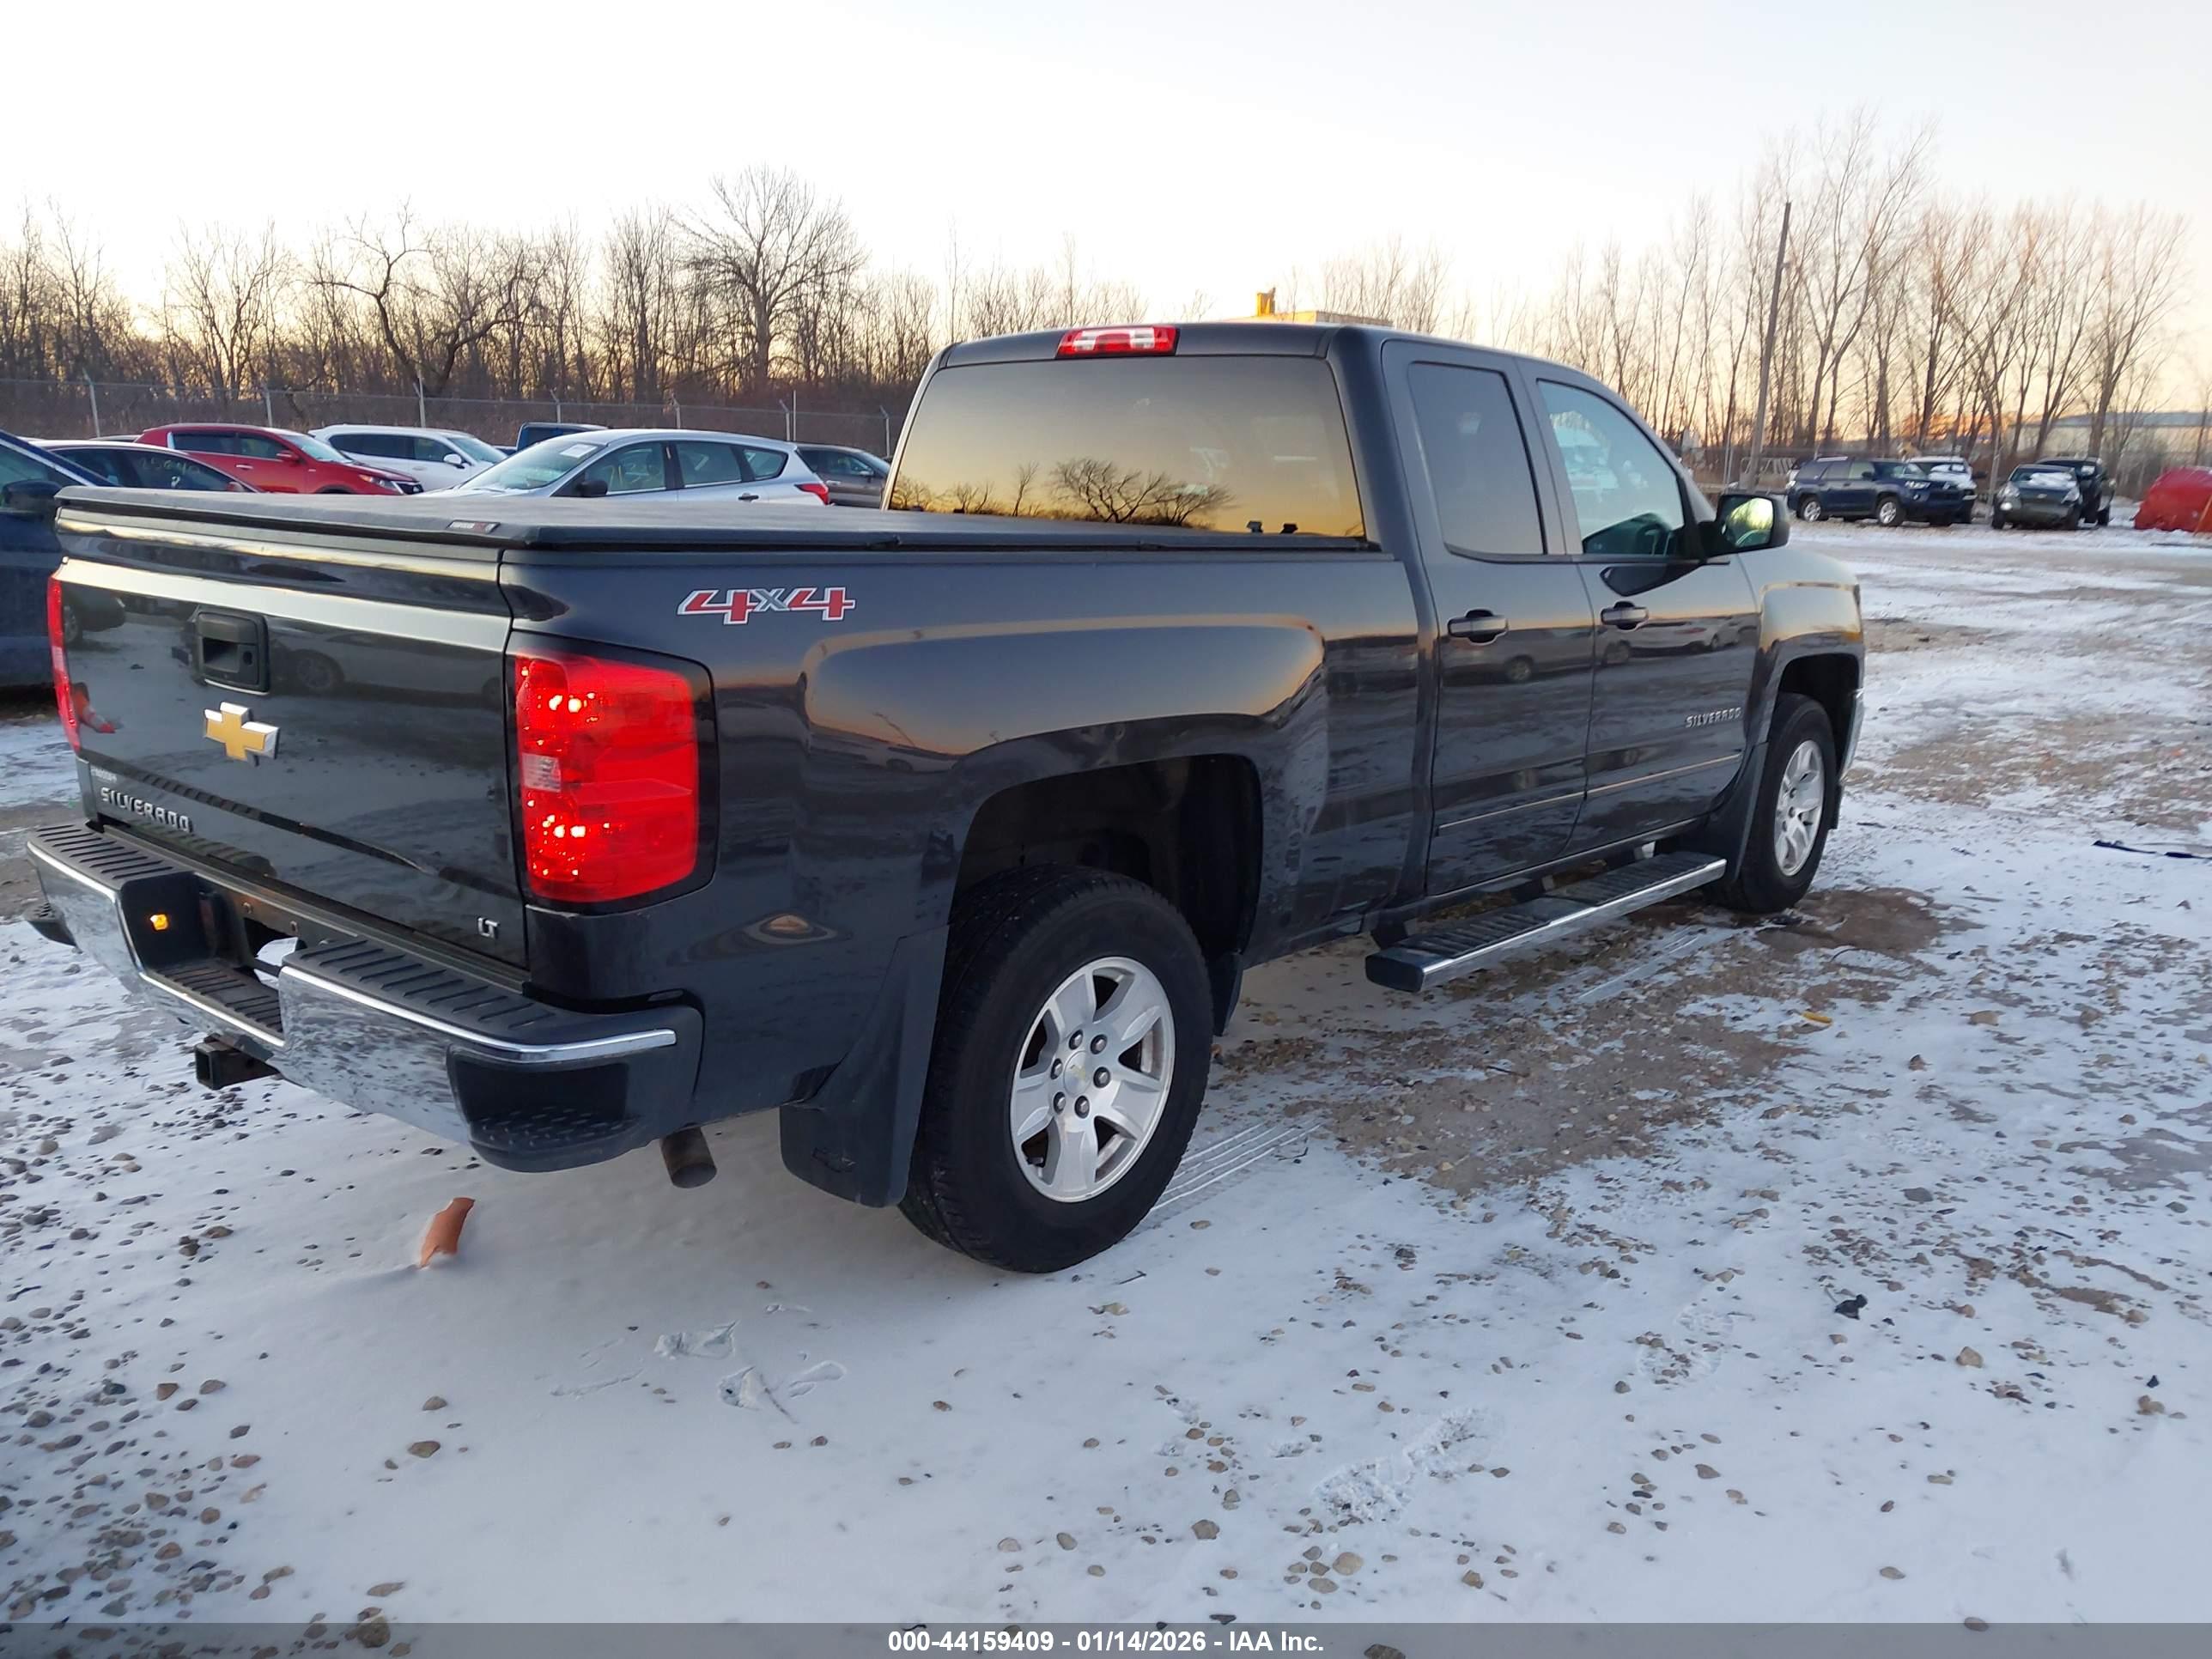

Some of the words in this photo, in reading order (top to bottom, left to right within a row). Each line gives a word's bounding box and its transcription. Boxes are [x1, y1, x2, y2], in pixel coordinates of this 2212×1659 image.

[1686, 707, 1742, 728] SILVERADO
[100, 787, 190, 832] SILVERADO
[477, 917, 498, 939] LT
